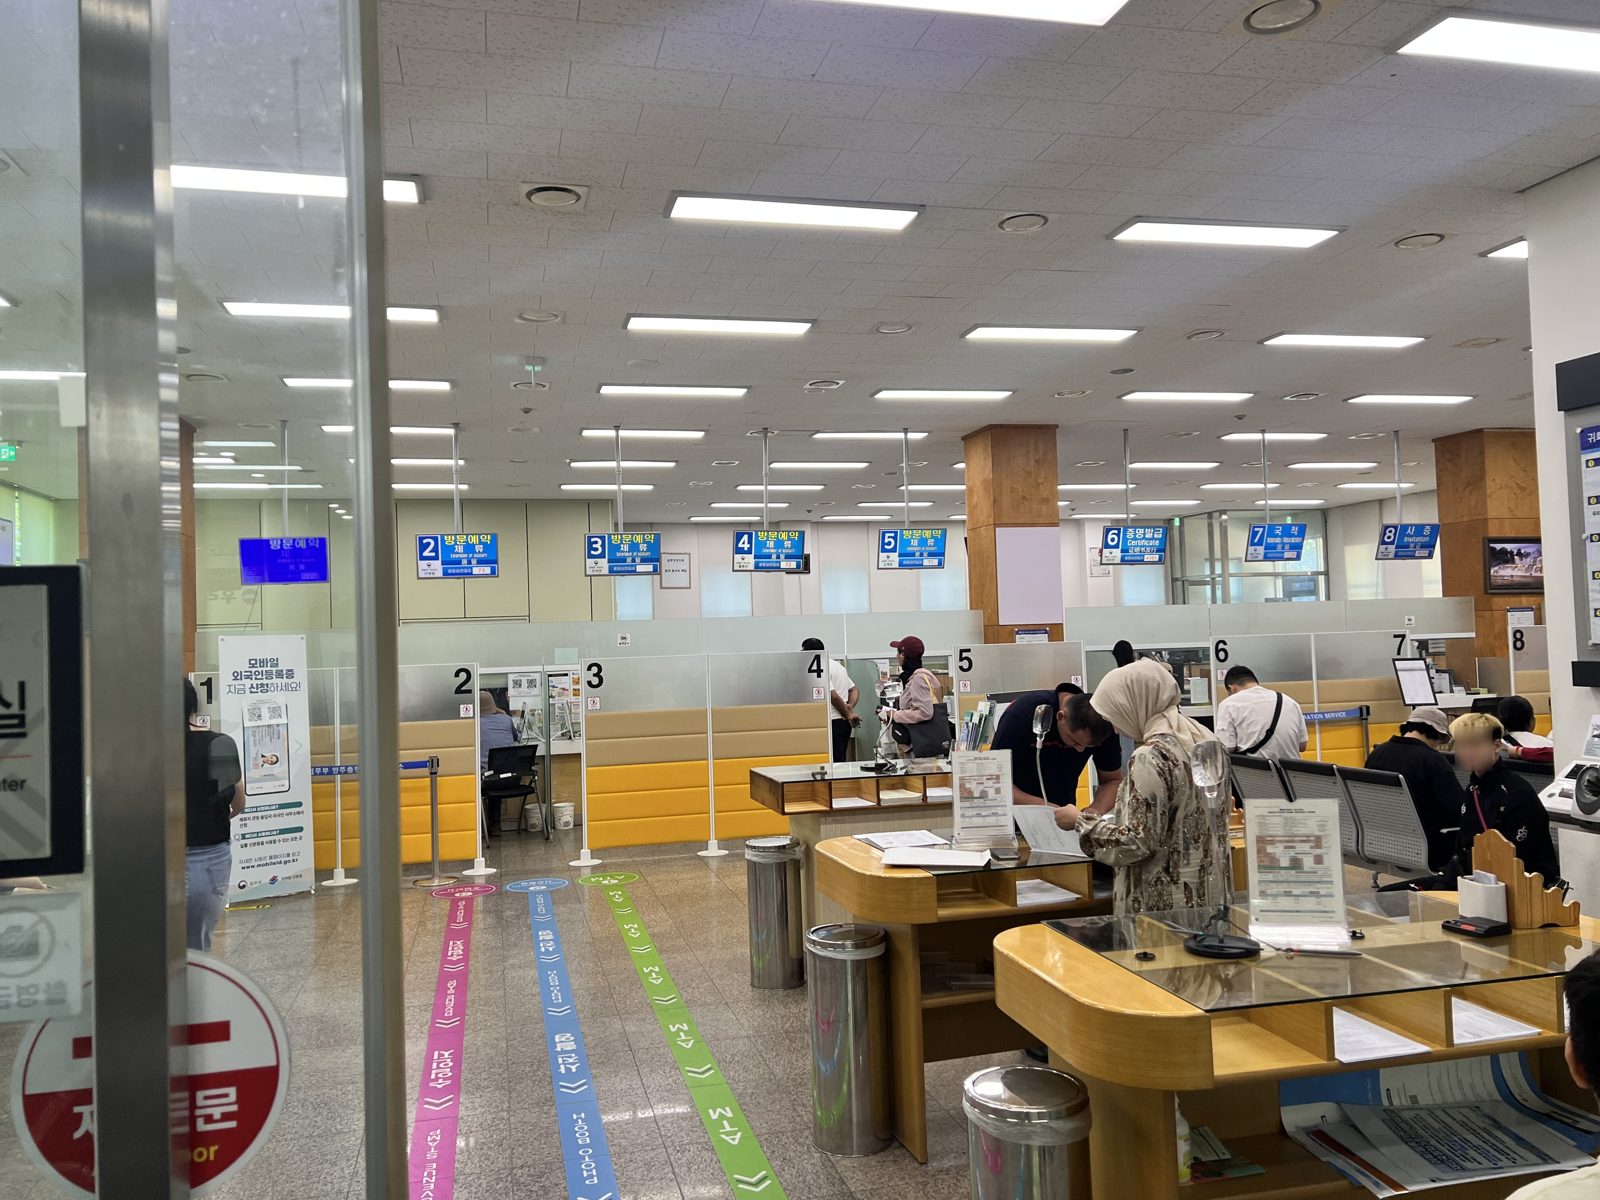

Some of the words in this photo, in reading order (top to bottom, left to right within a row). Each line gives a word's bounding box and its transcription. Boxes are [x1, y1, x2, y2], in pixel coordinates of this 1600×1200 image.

[444, 534, 491, 546] 방문예약
[611, 534, 655, 544] 방문예약
[737, 534, 750, 551] 4
[758, 531, 799, 541] 방문예약
[884, 533, 895, 549] 5
[903, 529, 941, 539] 방문예약
[1107, 530, 1119, 546] 6
[1126, 528, 1163, 539] 증명발급
[1254, 528, 1264, 543] 7
[1384, 527, 1395, 542] 8
[269, 538, 319, 550] 방문예약
[422, 538, 436, 557] 2
[590, 537, 603, 555] 3
[1393, 634, 1406, 655] 7
[1512, 629, 1525, 651] 8
[1214, 639, 1229, 663] 6
[248, 658, 279, 669] 모바일
[807, 654, 823, 679] 4
[958, 648, 973, 673] 5
[232, 669, 295, 681] 외국인등록증
[454, 668, 472, 694] 2
[586, 662, 604, 688] 3
[199, 677, 213, 705] 1
[226, 684, 246, 694] 지금
[248, 681, 301, 694] 신청하세요!
[1324, 711, 1346, 719] SERVICE
[0, 778, 26, 792] ter
[609, 890, 624, 902] ATM
[624, 923, 641, 938] ATM
[643, 965, 663, 985] ATM
[669, 1023, 695, 1049] ATM
[429, 1049, 454, 1089] 수입인지
[557, 1054, 580, 1074] 사진
[573, 1112, 590, 1145] BOOTH
[708, 1106, 742, 1145] ATM
[425, 1129, 440, 1160] STAMP
[191, 1145, 218, 1164] or
[579, 1148, 598, 1185] PHOTO
[419, 1162, 437, 1200] VENUE
